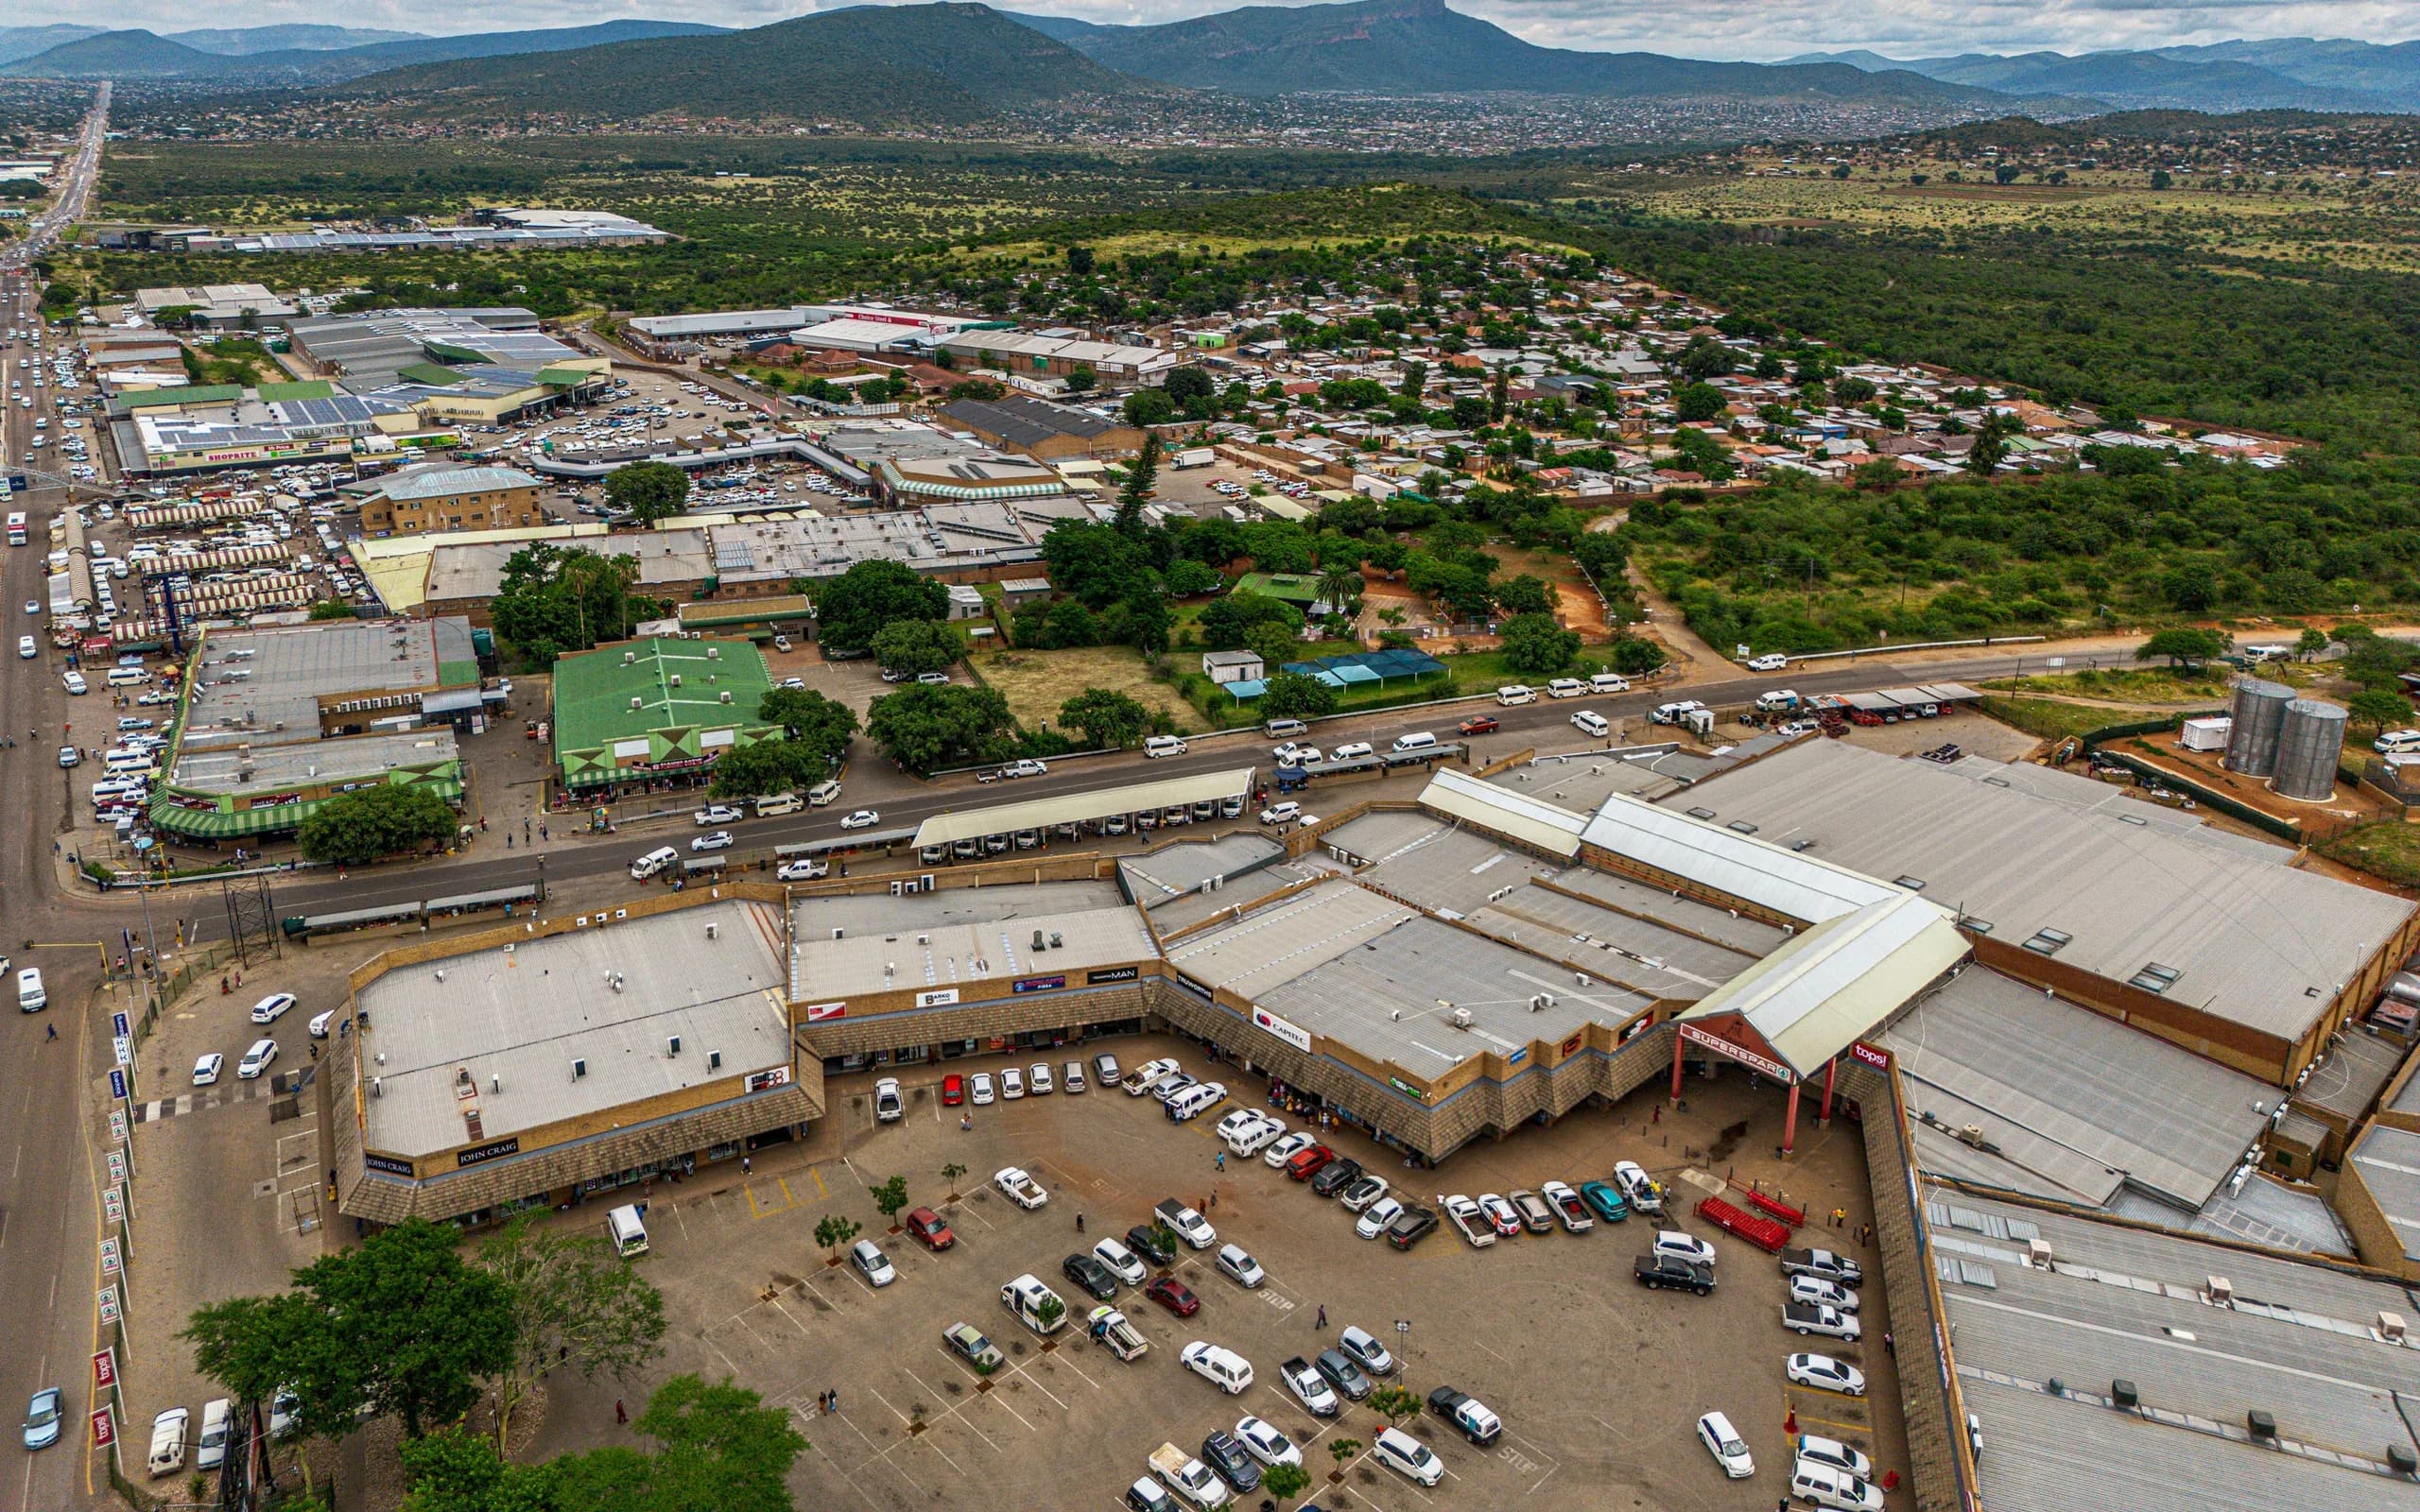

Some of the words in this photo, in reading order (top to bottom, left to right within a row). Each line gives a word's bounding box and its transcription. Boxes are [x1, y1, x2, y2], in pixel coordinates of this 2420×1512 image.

[208, 452, 256, 461] SHOPRITE
[1111, 970, 1134, 980] MAN
[1272, 1023, 1306, 1044] CAPITEC
[1691, 1030, 1777, 1074] SUPERSPAR
[460, 1150, 485, 1164] JOHN
[487, 1142, 517, 1156] CRAIG
[367, 1158, 387, 1169] JOHN
[387, 1162, 411, 1174] CRAIG
[1258, 1289, 1295, 1310] STOP
